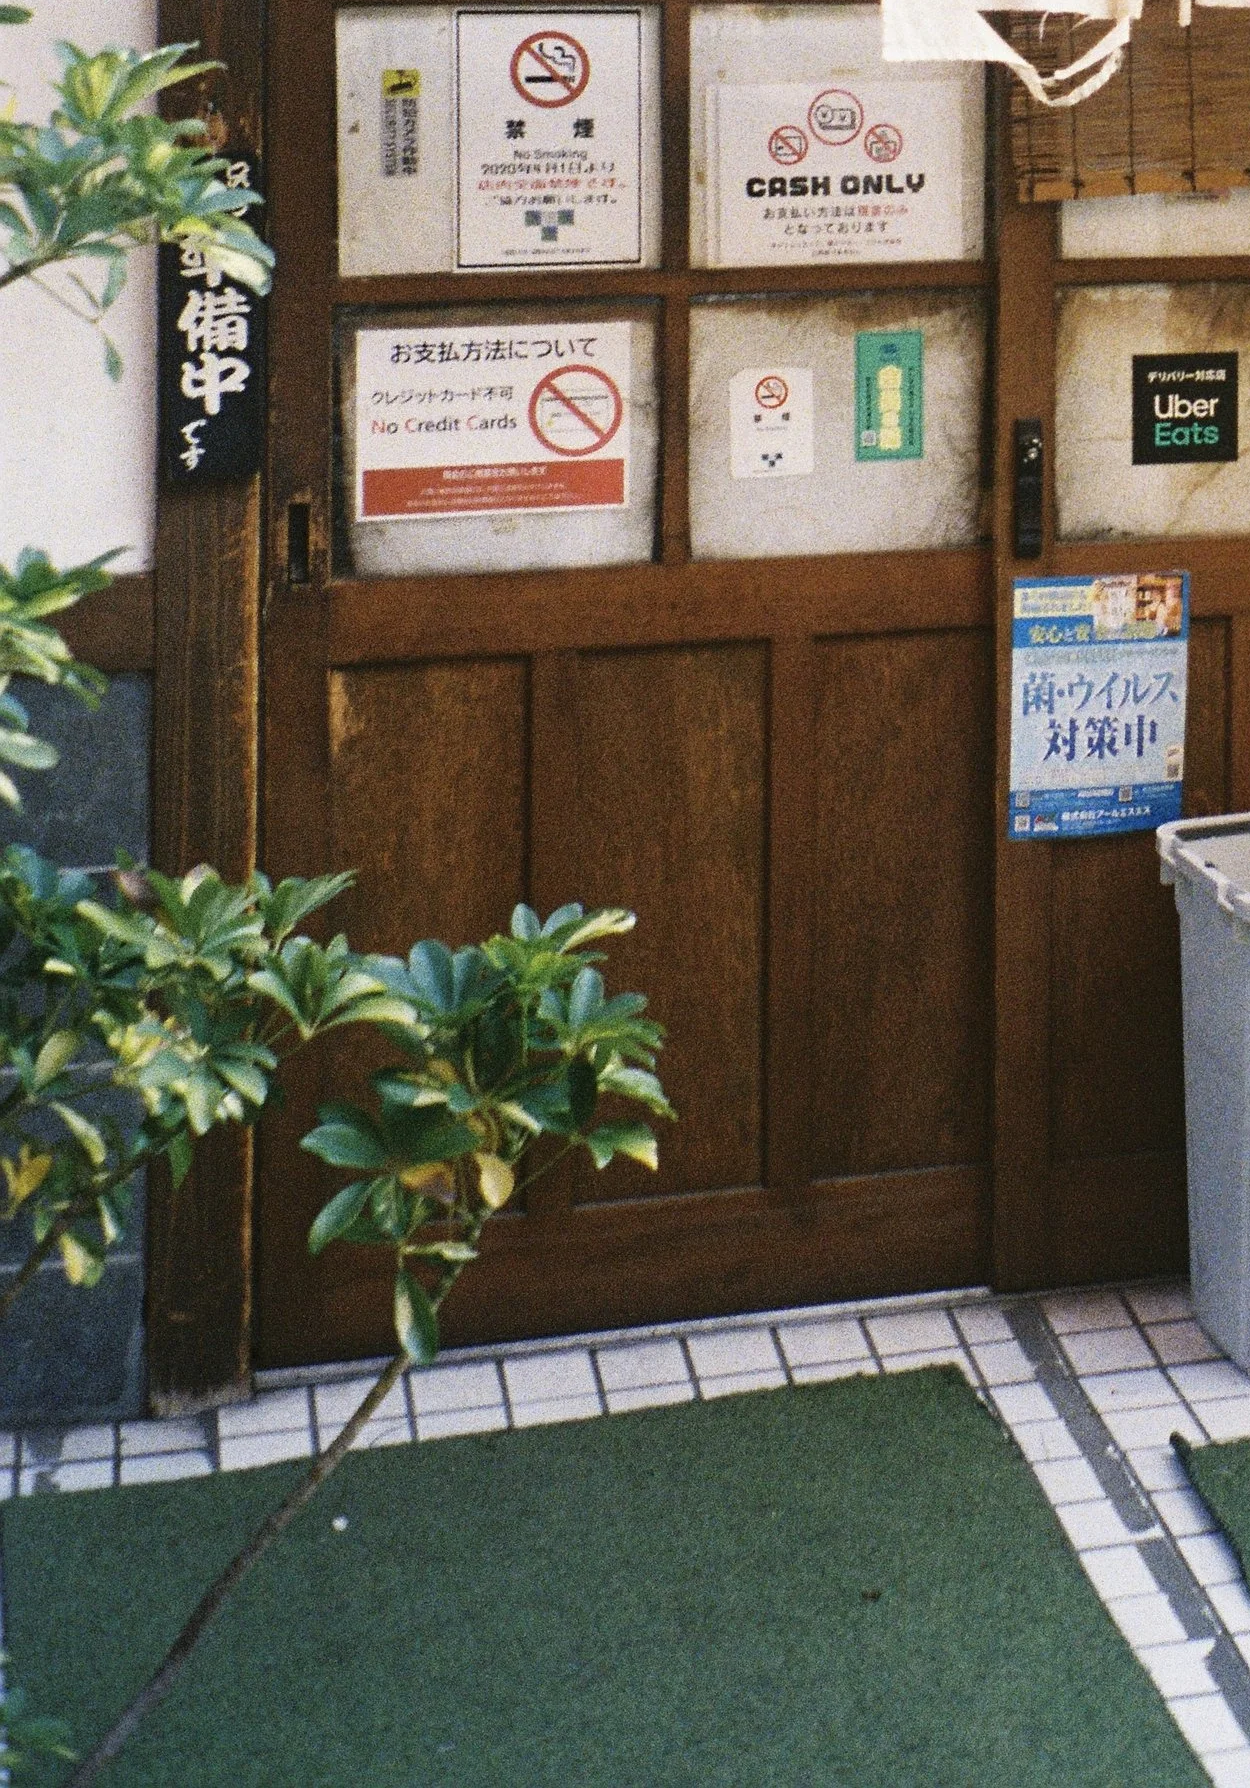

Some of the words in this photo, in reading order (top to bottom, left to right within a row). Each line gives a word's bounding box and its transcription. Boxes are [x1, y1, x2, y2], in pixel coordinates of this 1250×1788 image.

[505, 118, 595, 140] 禁煙
[513, 150, 531, 160] No
[534, 149, 588, 161] Smoking
[746, 175, 831, 198] CASH
[841, 173, 926, 196] ONLY
[784, 221, 889, 236] となっております
[391, 337, 598, 364] お支払方法について
[1148, 369, 1226, 383] デリバリー対応店
[371, 386, 515, 405] クレジットカード不可
[1154, 394, 1219, 418] Uber
[371, 420, 398, 435] No
[405, 416, 460, 434] Credit
[466, 414, 518, 431] Cards
[1155, 422, 1219, 446] Eats
[1022, 671, 1179, 716] 菌・ウイルス
[1042, 715, 1158, 761] 対策中
